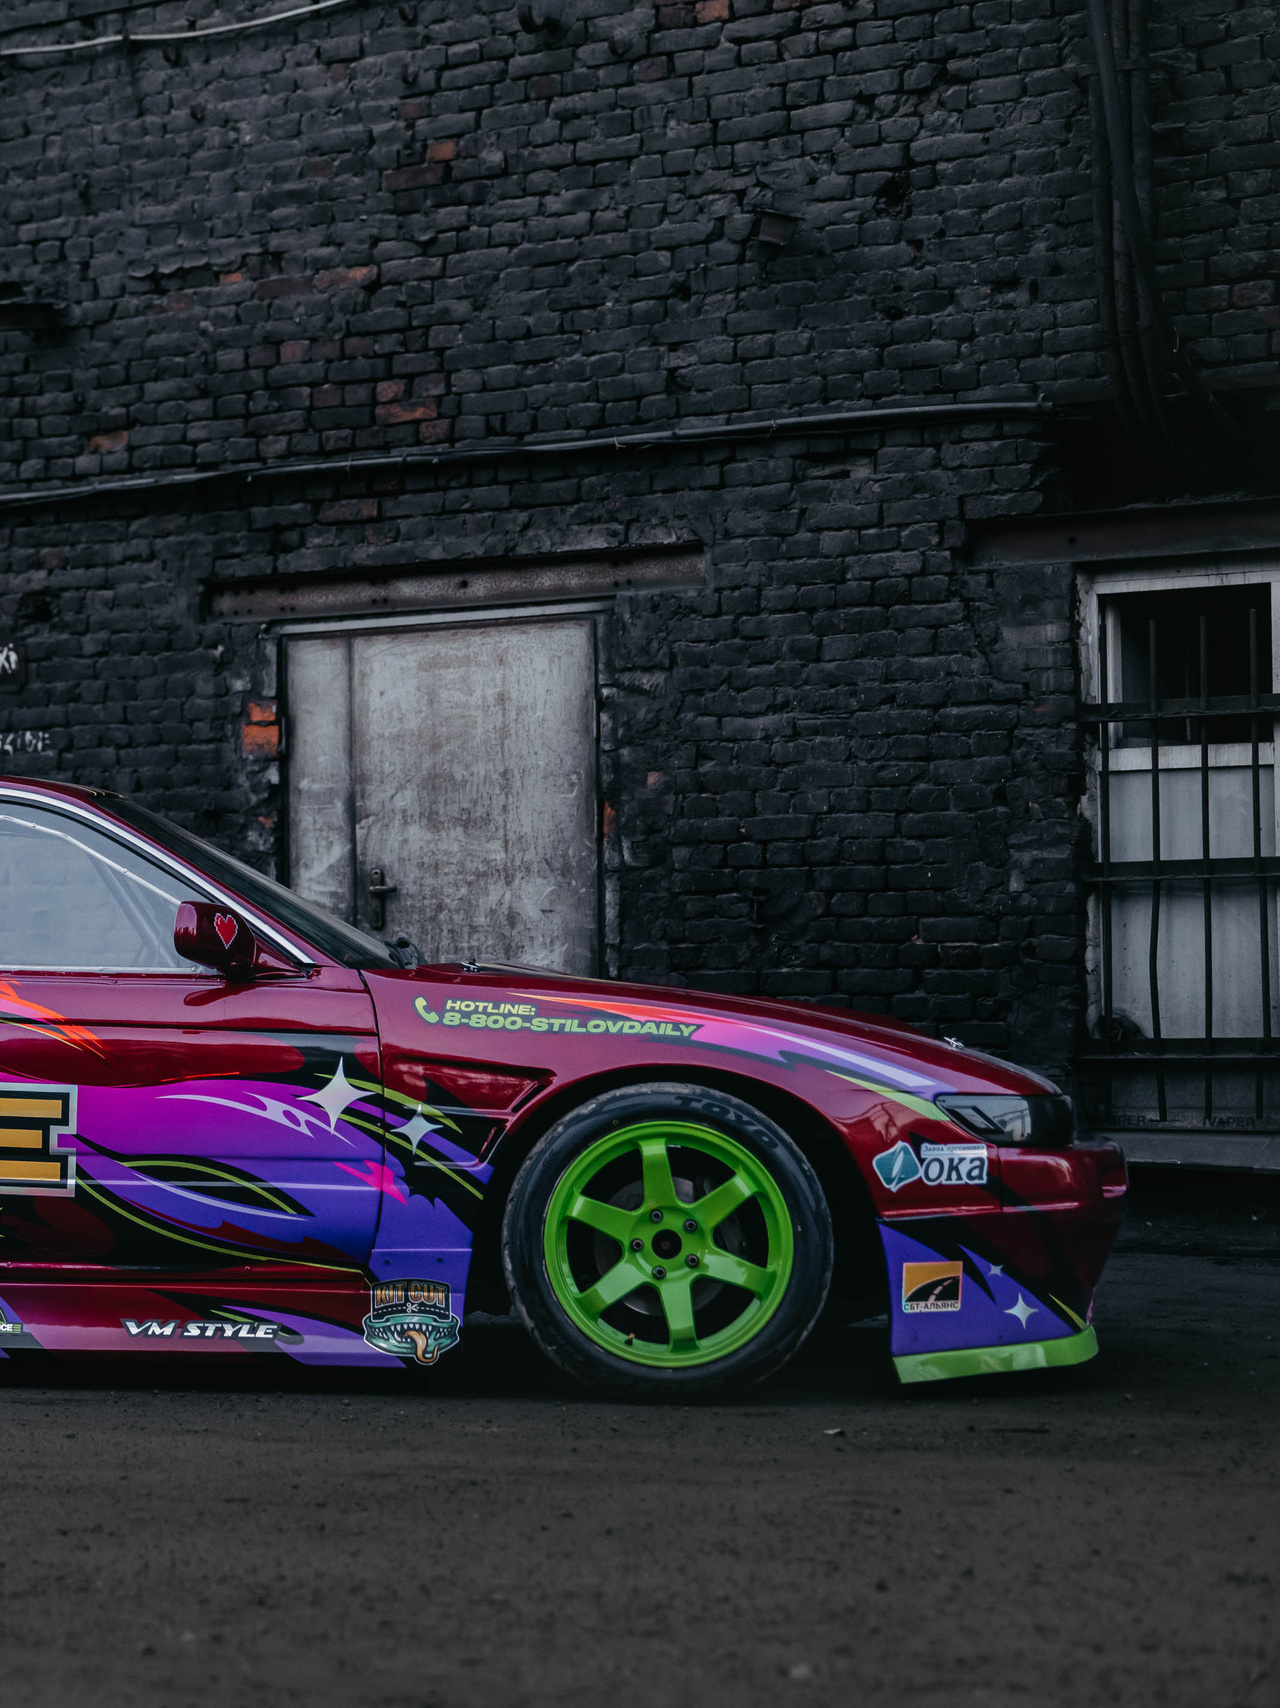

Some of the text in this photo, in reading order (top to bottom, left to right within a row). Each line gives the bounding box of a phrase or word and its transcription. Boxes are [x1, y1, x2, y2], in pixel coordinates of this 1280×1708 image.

[445, 1000, 536, 1016] HOTLINE:
[443, 1012, 698, 1037] 8-800-STILOVDAILY
[675, 1095, 779, 1150] TOYO
[375, 1281, 446, 1308] KIT CUT
[903, 1302, 959, 1311] СБТ-АЛЬЯНС
[125, 1321, 278, 1338] VM STYLE
